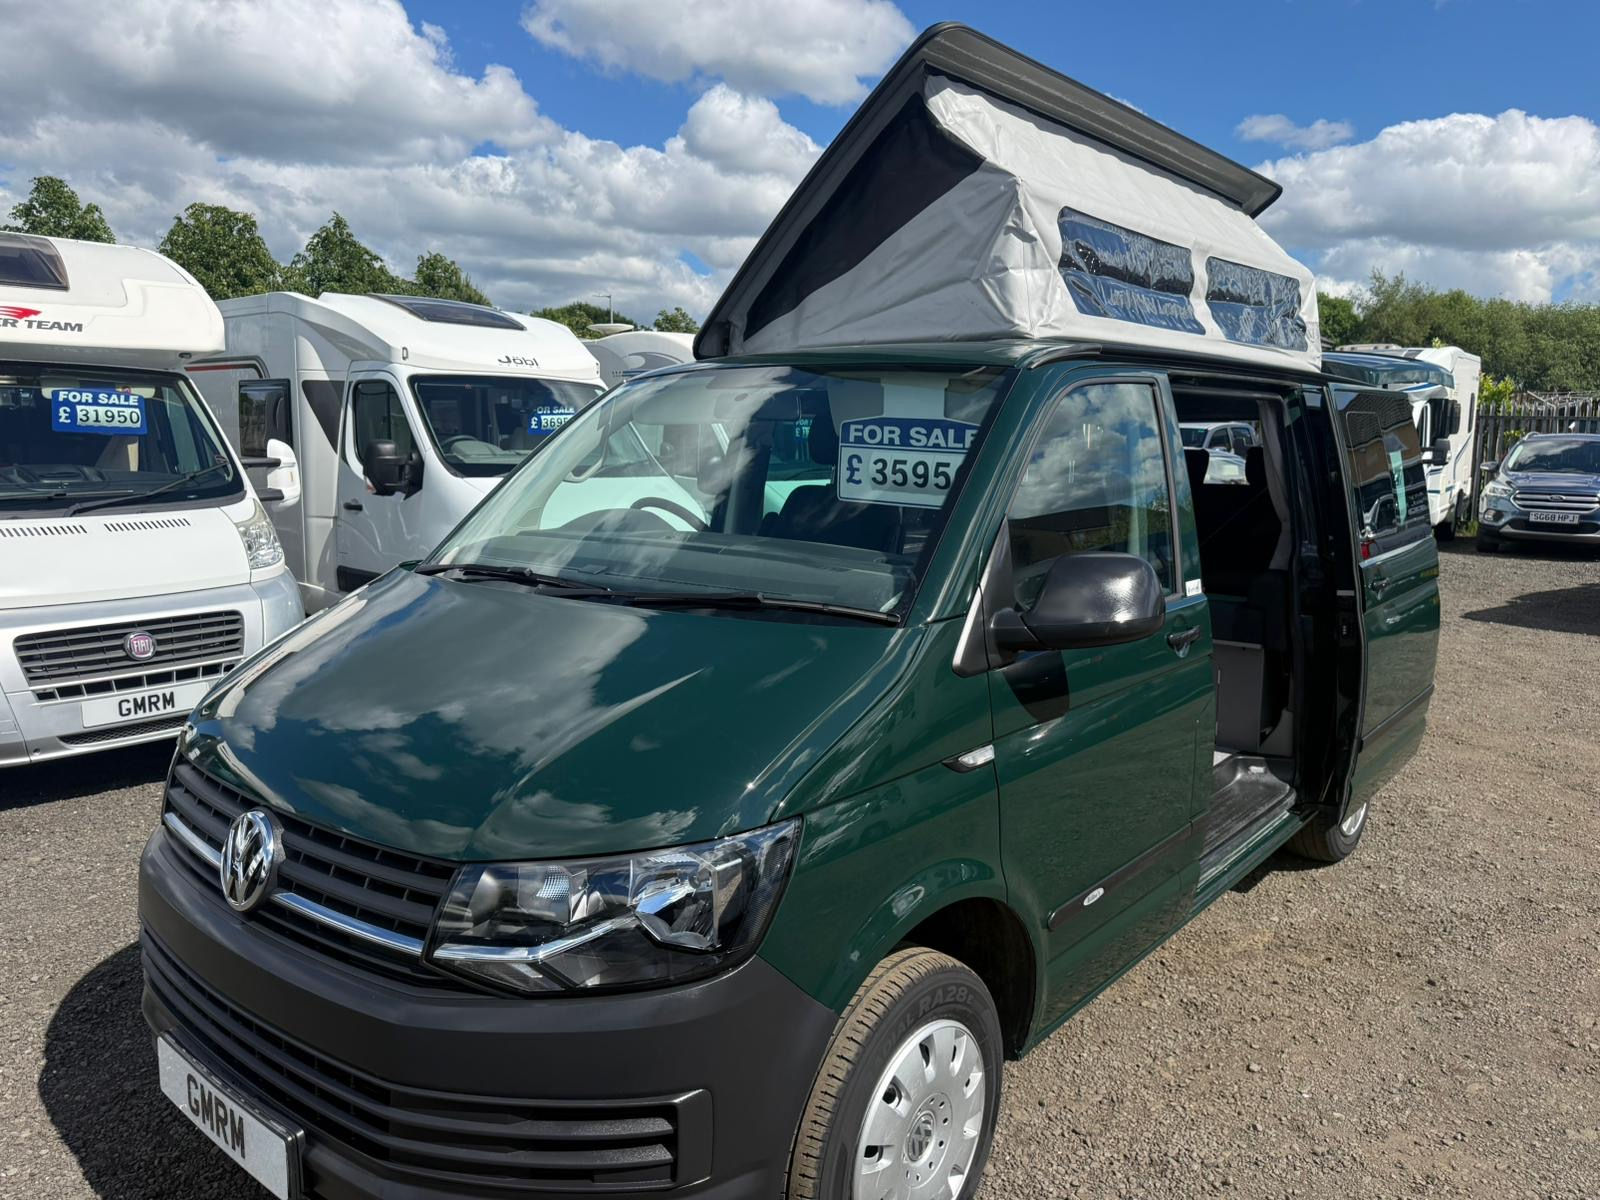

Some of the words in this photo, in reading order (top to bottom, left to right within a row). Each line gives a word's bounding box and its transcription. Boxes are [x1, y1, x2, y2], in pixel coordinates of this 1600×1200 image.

[24, 319, 83, 332] TEAM
[58, 391, 93, 403] FOR
[97, 393, 139, 406] SALE
[79, 408, 140, 424] 31950
[849, 424, 901, 445] FOR
[846, 454, 863, 485] £
[871, 458, 951, 490] 3595
[118, 691, 175, 717] GMRM
[186, 1073, 246, 1160] GMRM
